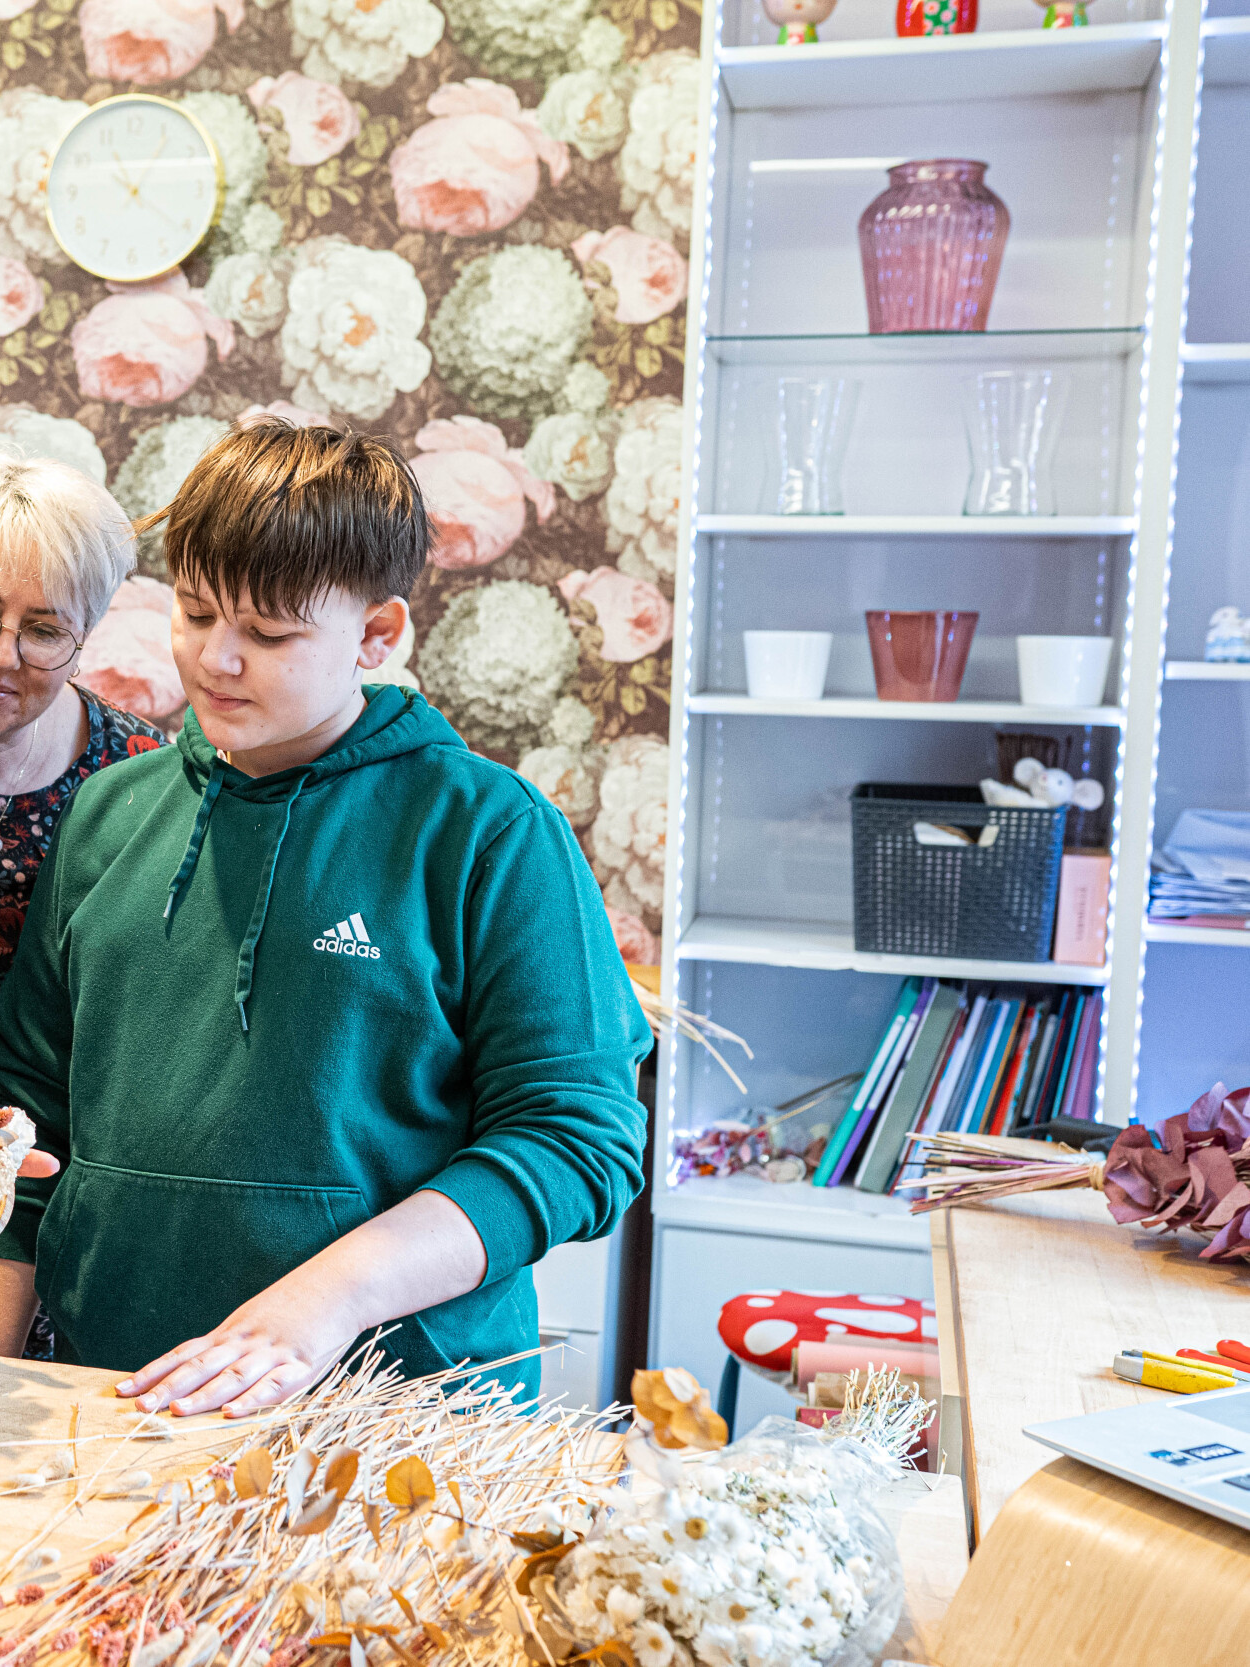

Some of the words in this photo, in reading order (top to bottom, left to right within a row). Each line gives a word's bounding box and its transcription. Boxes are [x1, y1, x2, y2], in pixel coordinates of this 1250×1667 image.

[127, 117, 143, 134] 12
[100, 129, 113, 144] 11
[67, 184, 78, 202] 9
[99, 238, 109, 257] 7
[127, 247, 137, 265] 6
[313, 937, 381, 960] adidas
